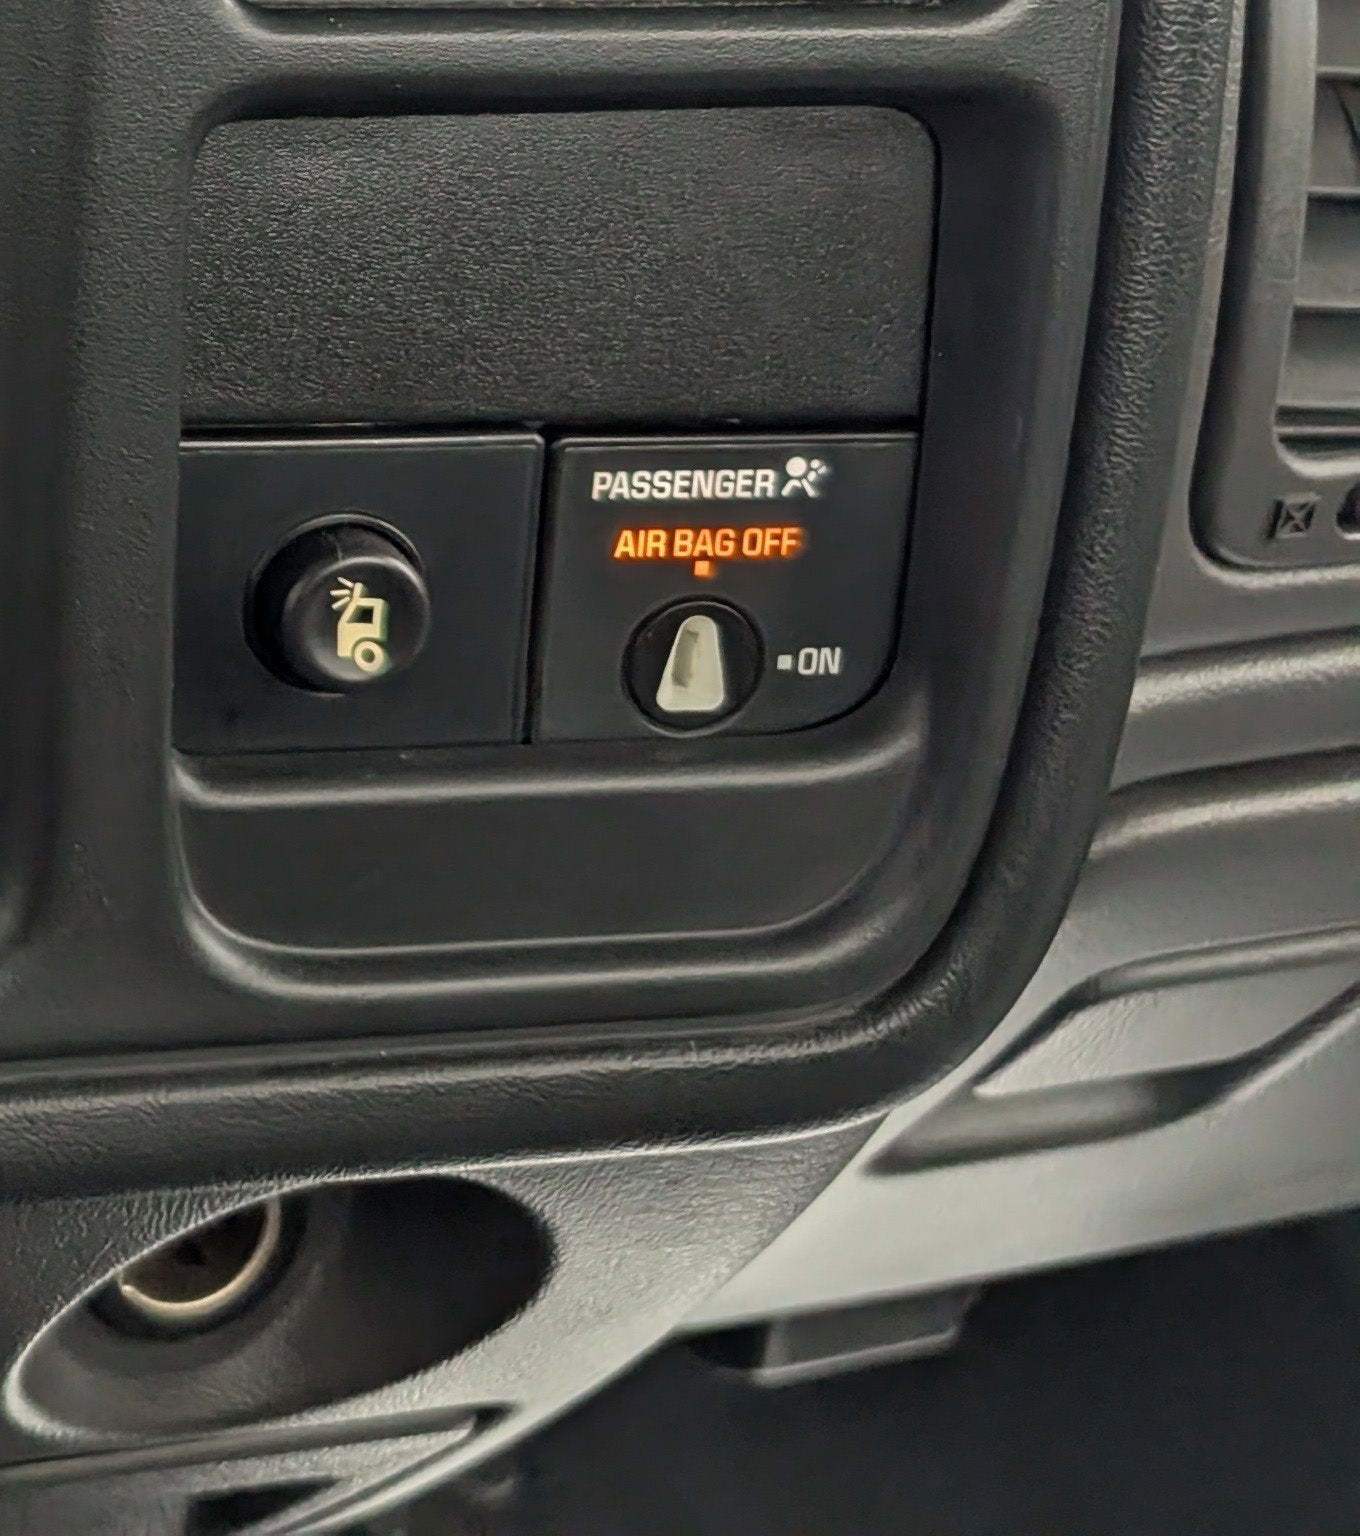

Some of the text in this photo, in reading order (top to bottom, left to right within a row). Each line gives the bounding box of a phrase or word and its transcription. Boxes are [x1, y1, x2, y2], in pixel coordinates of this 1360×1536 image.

[591, 468, 777, 500] PASSENGER
[613, 527, 801, 559] AIR BAG OFF
[797, 646, 841, 676] ON
